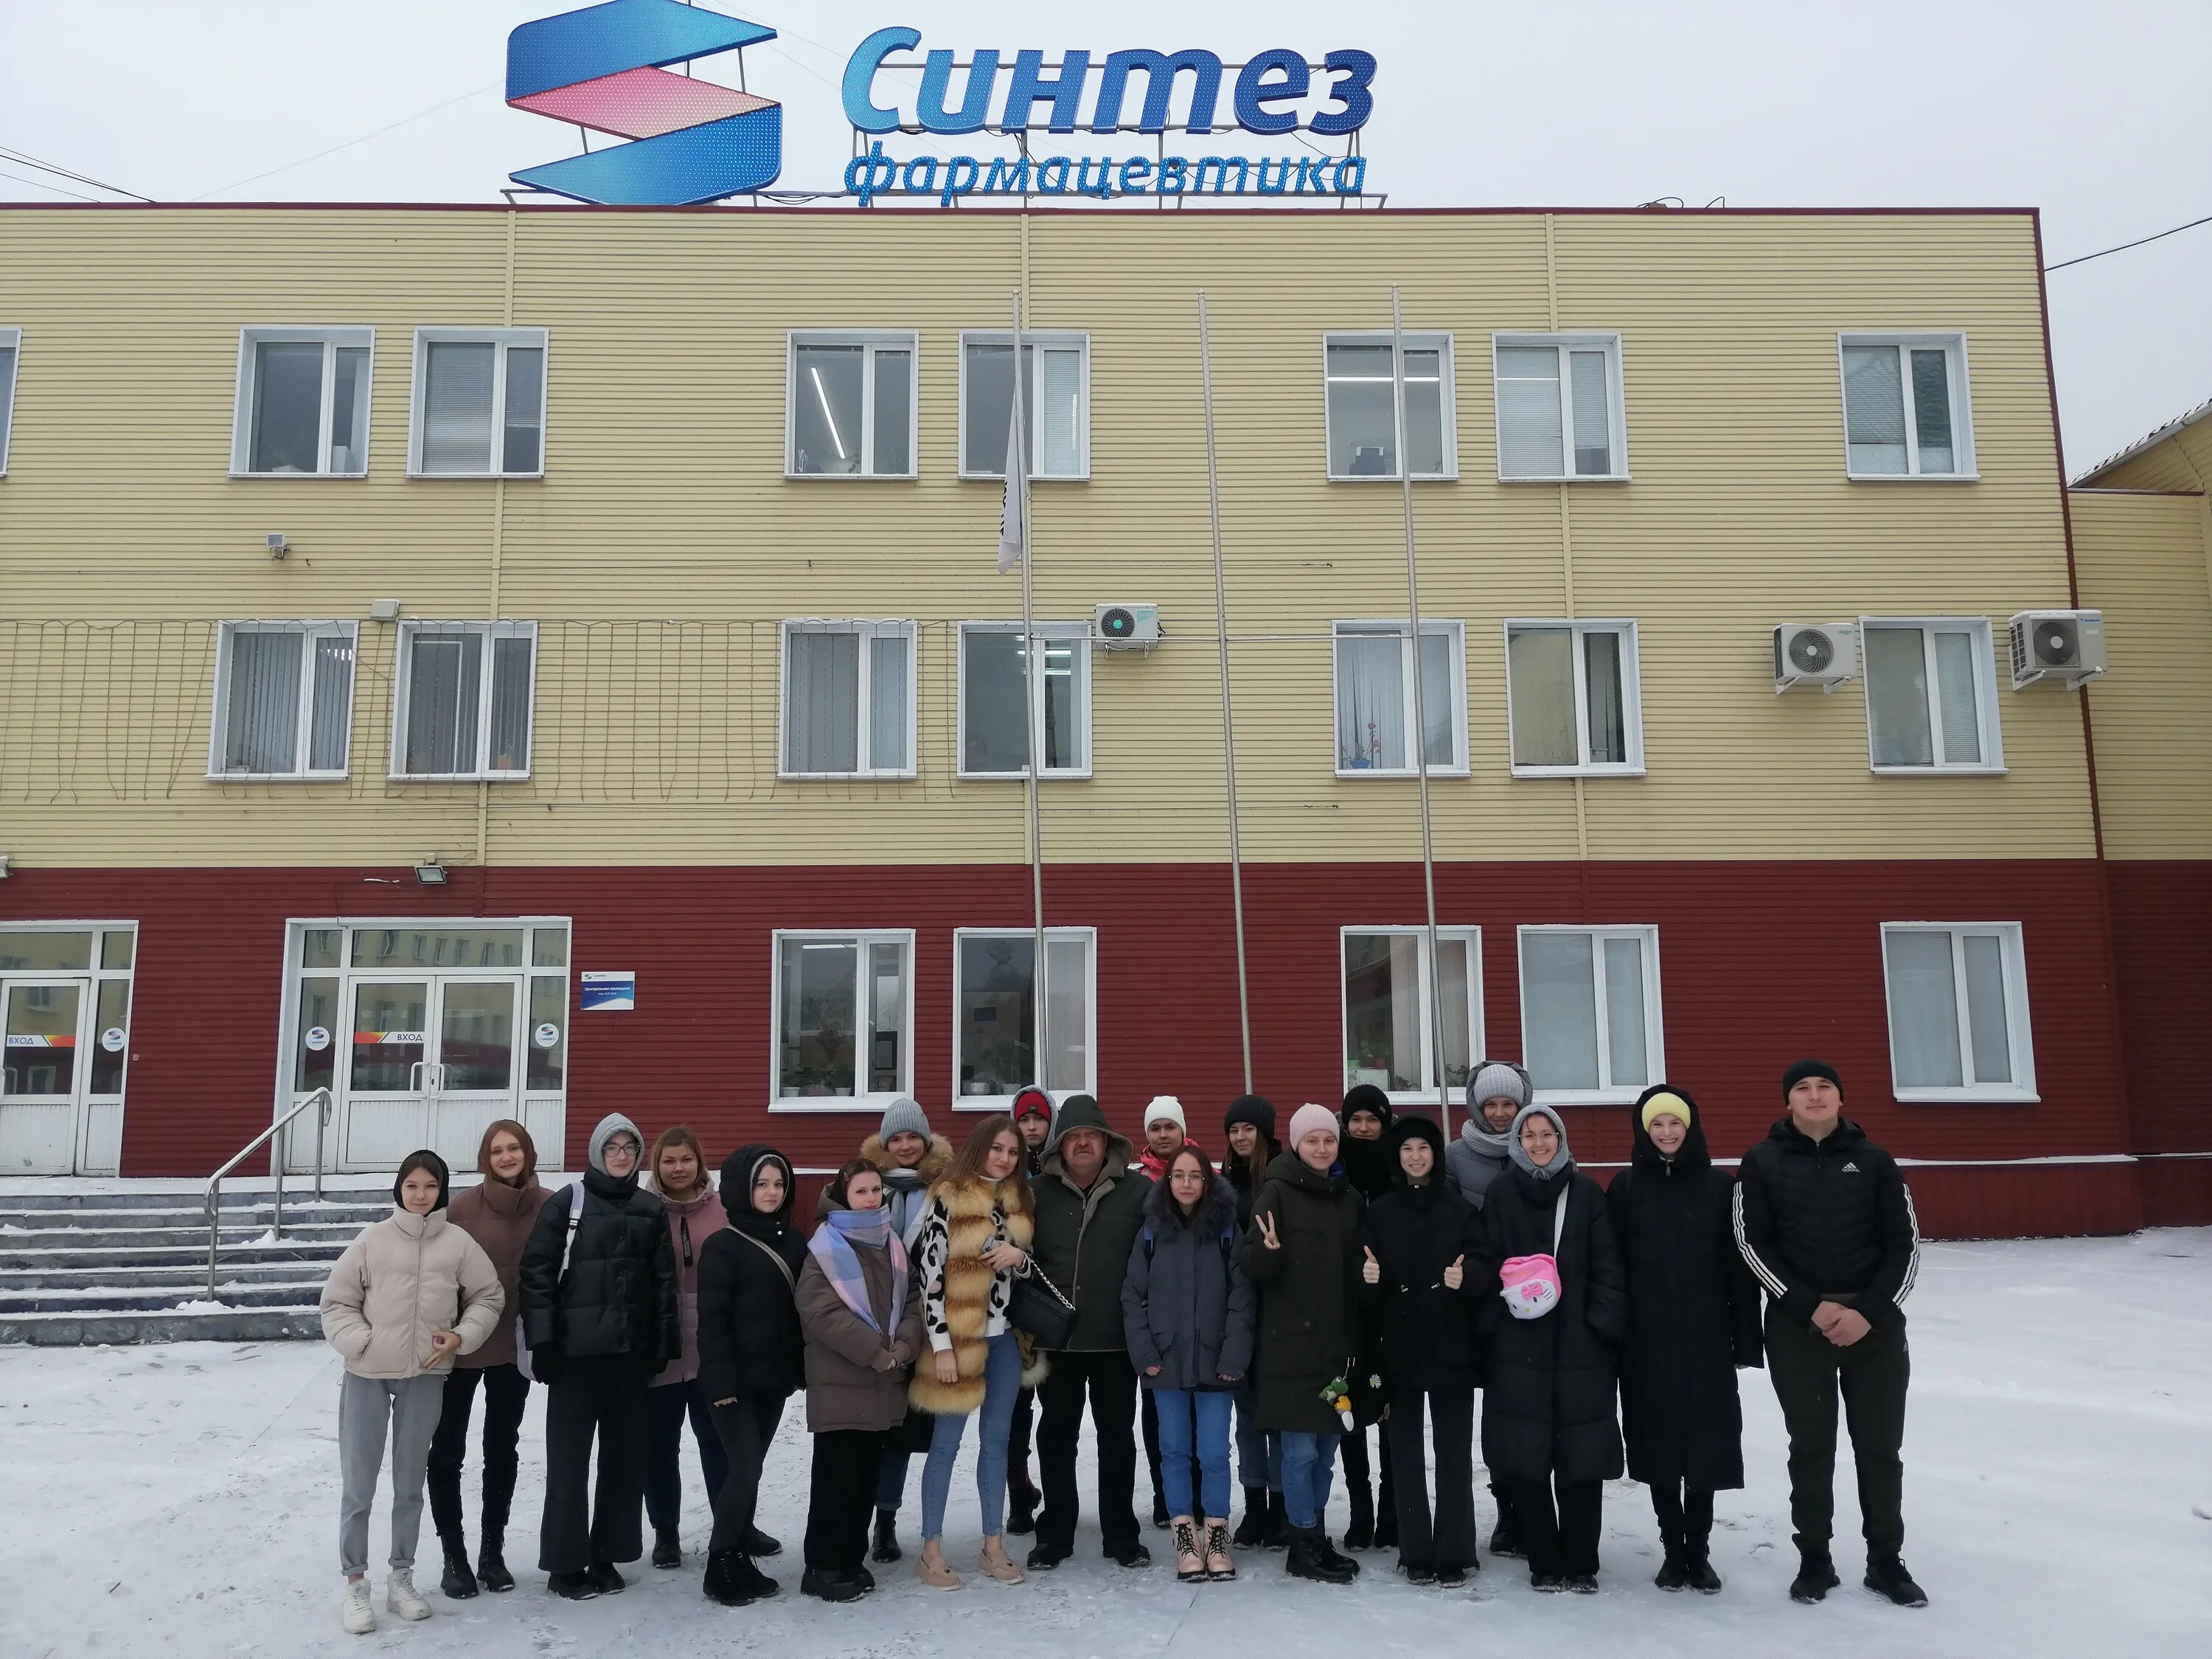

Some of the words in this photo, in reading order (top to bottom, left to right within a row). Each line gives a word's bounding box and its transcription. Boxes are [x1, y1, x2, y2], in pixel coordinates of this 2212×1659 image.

[841, 26, 1377, 136] Синтез
[844, 141, 1367, 208] фармацевтика
[9, 1037, 34, 1045] ВХОД
[397, 1034, 423, 1042] ВХОД
